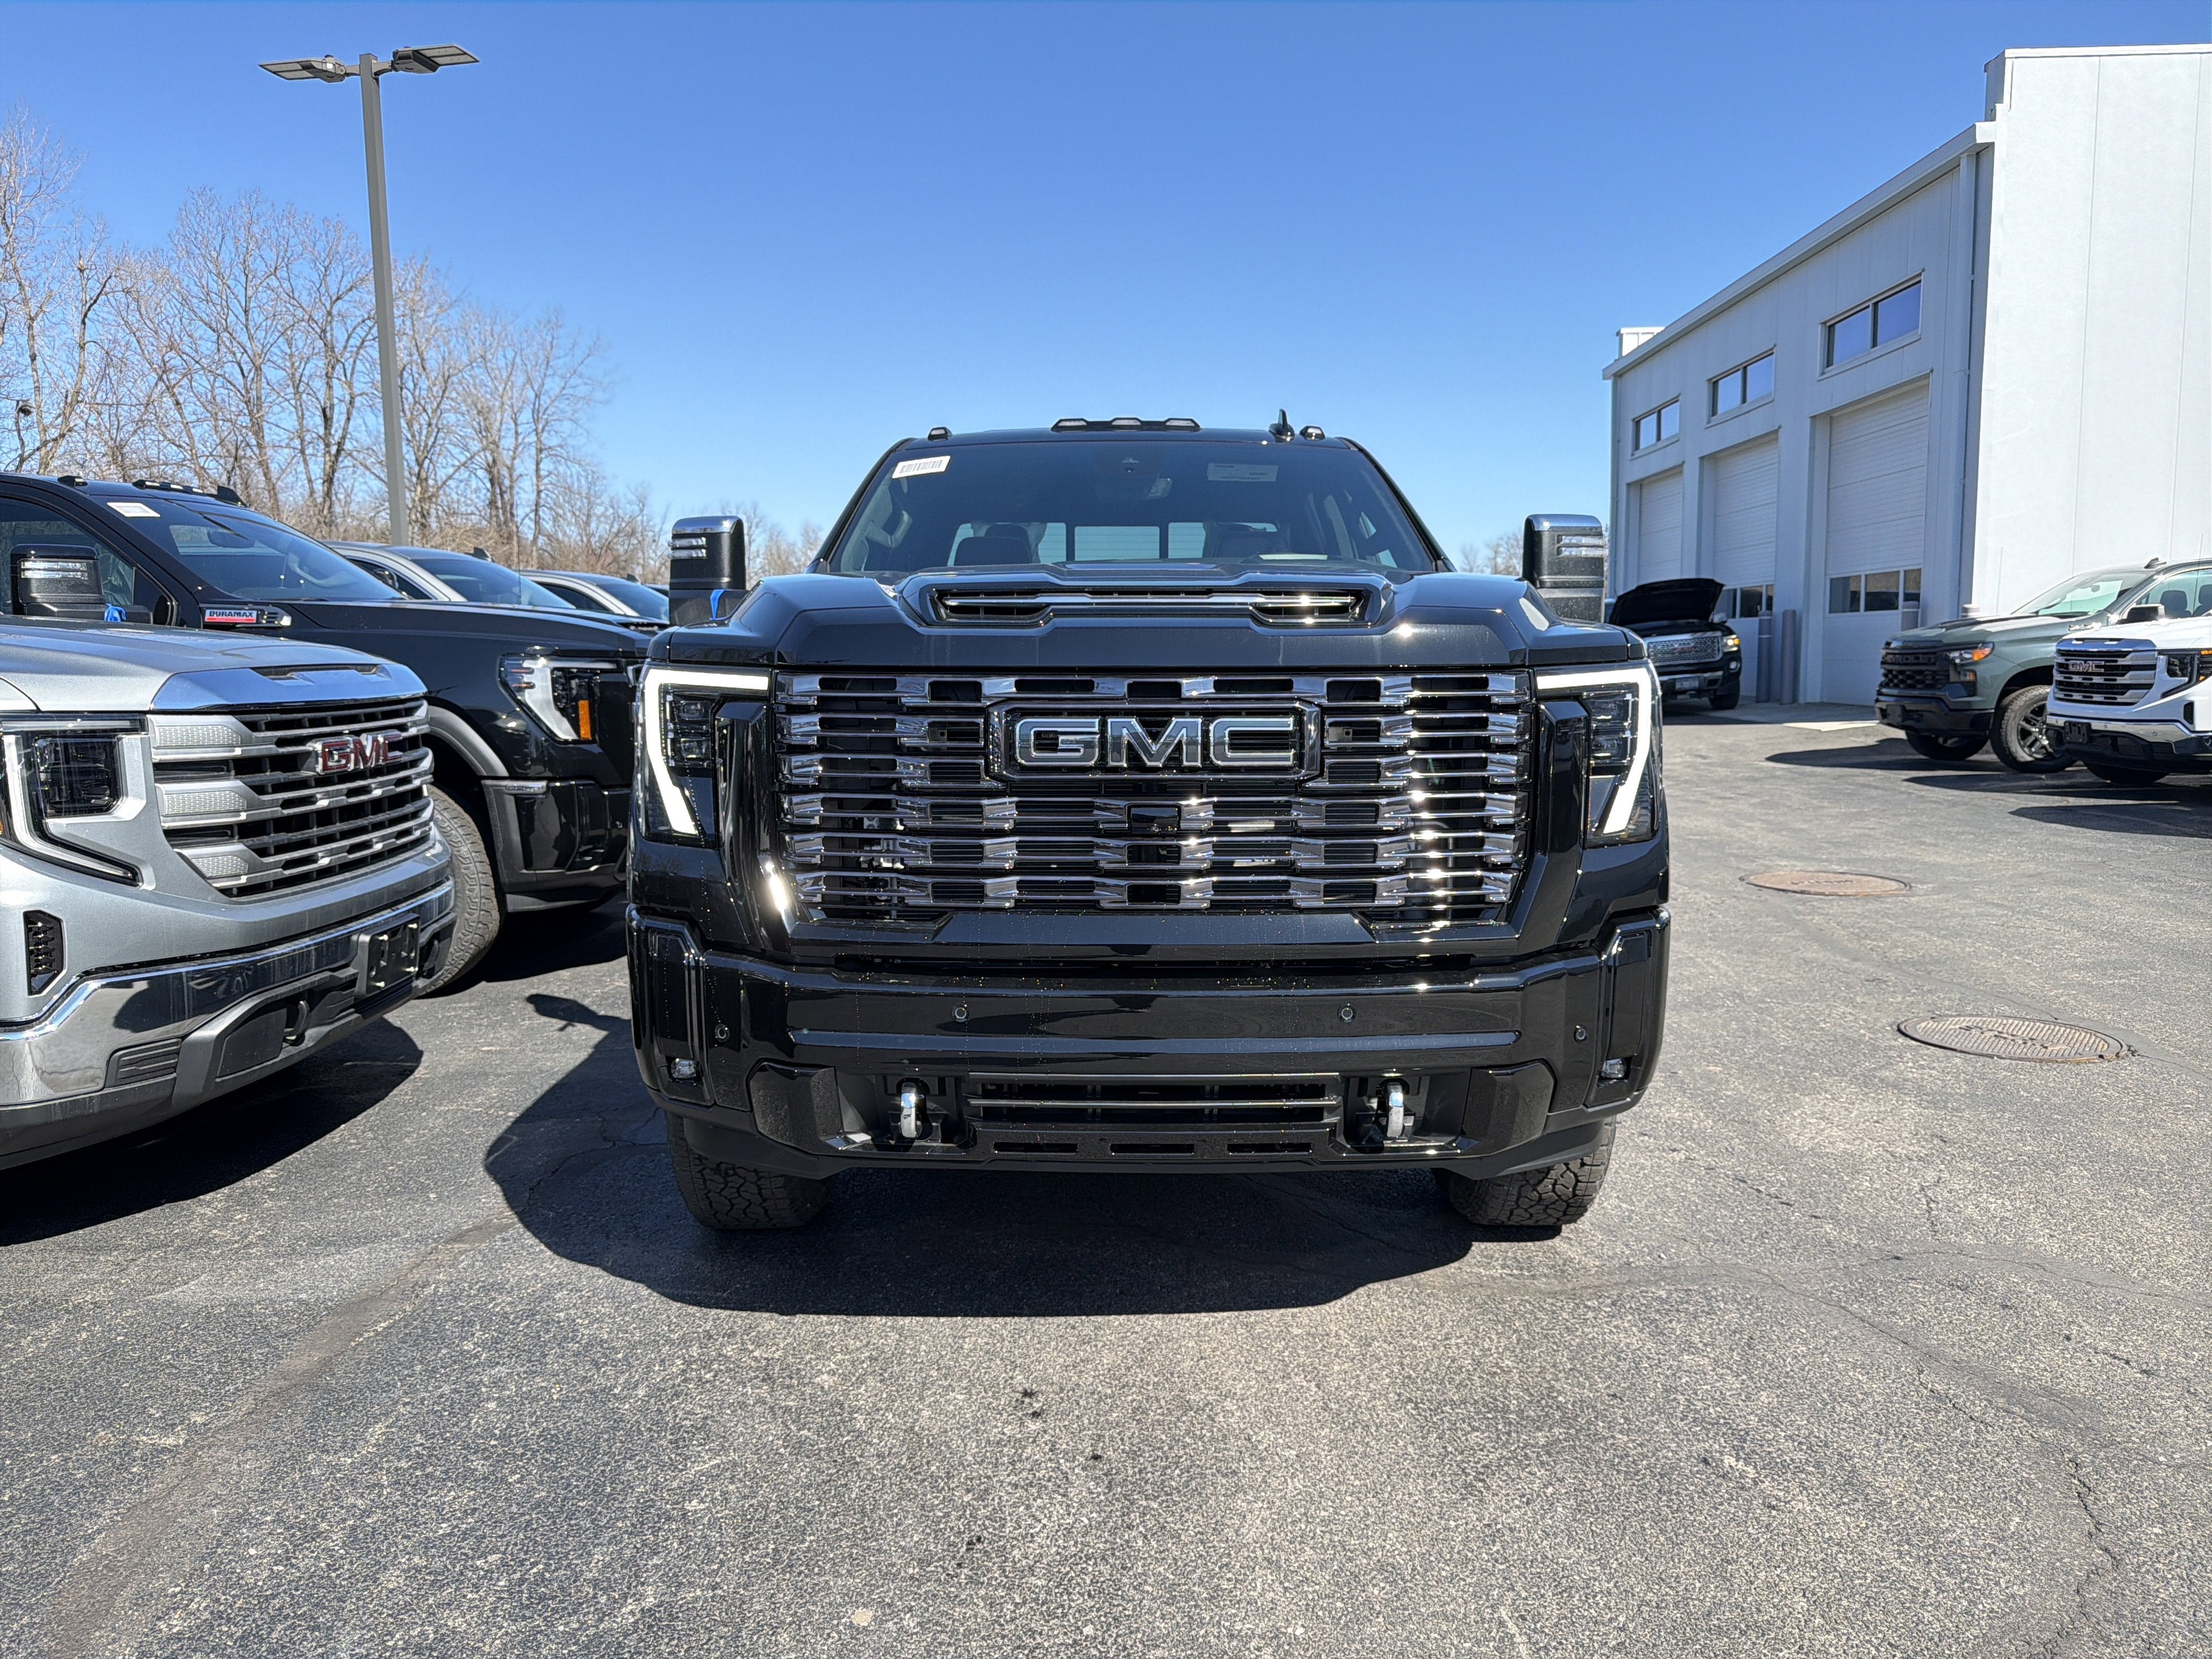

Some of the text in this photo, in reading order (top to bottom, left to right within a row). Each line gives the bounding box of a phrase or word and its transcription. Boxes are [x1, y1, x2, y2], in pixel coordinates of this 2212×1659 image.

[2068, 661, 2104, 673] GMC
[316, 730, 403, 774] GMC
[1015, 715, 1294, 767] GMC
